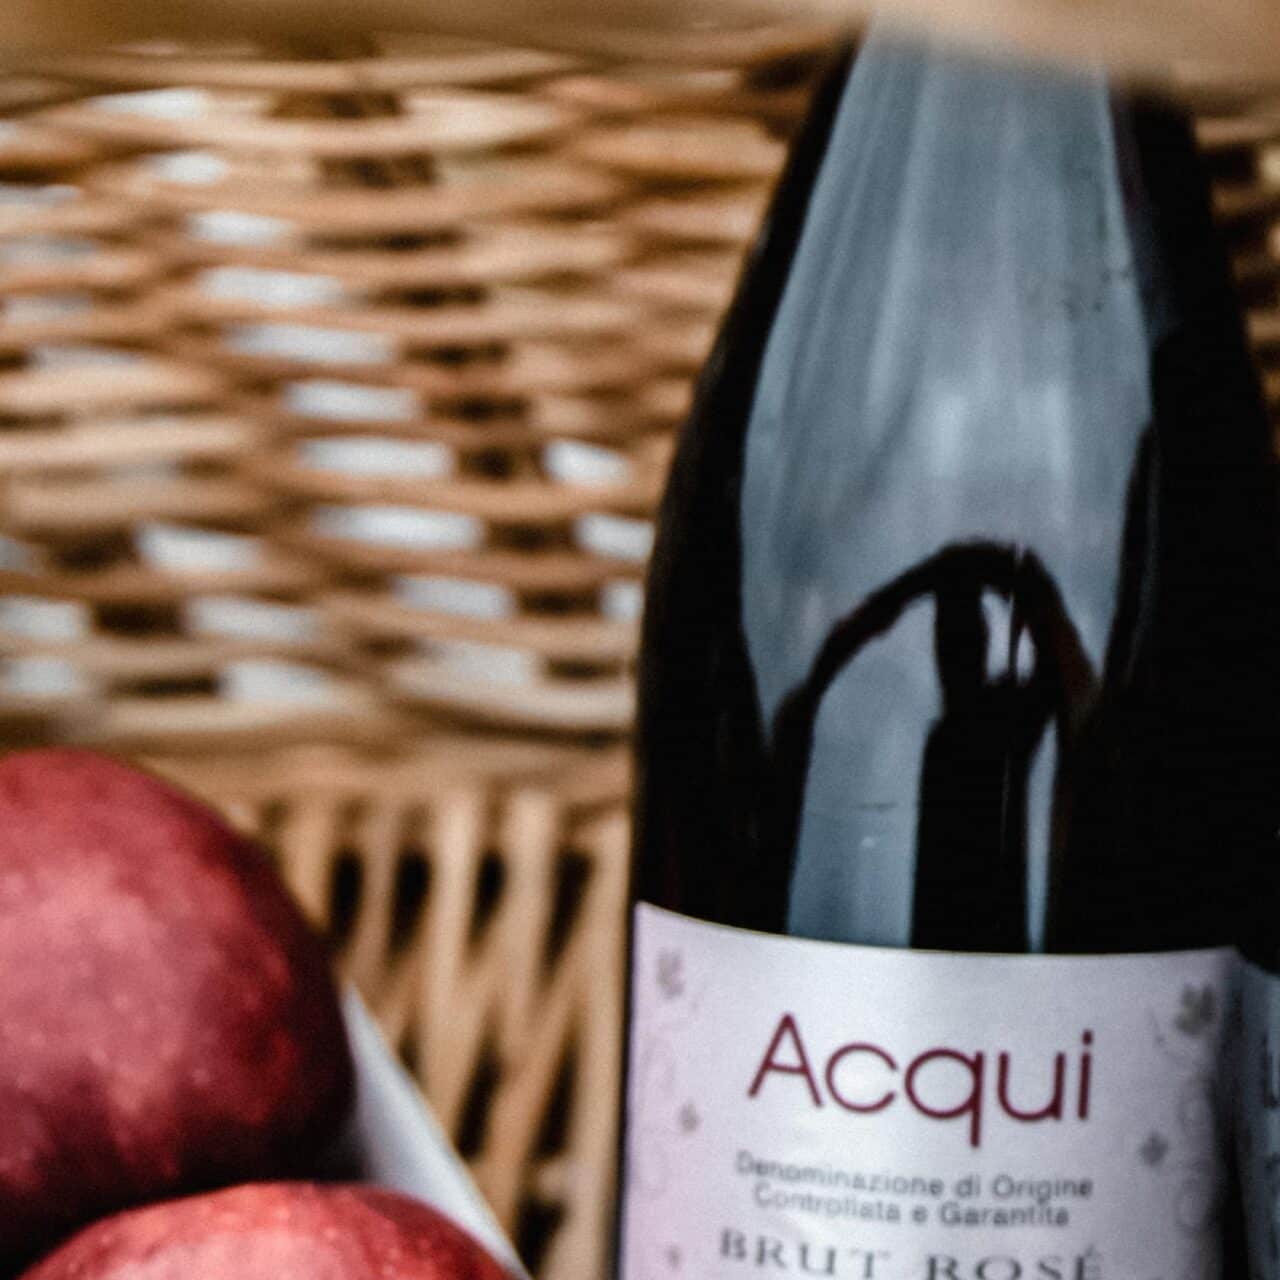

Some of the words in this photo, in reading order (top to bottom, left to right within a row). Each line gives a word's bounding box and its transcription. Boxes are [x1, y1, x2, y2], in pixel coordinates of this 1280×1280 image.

[747, 1013, 1093, 1149] Acqui
[735, 1149, 944, 1195] Denominazione
[955, 1174, 981, 1197] di
[993, 1174, 1093, 1205] Origine
[754, 1182, 901, 1223] Controllata
[912, 1206, 929, 1224] e
[940, 1200, 1070, 1227] Garantita
[719, 1227, 891, 1280] BRUT
